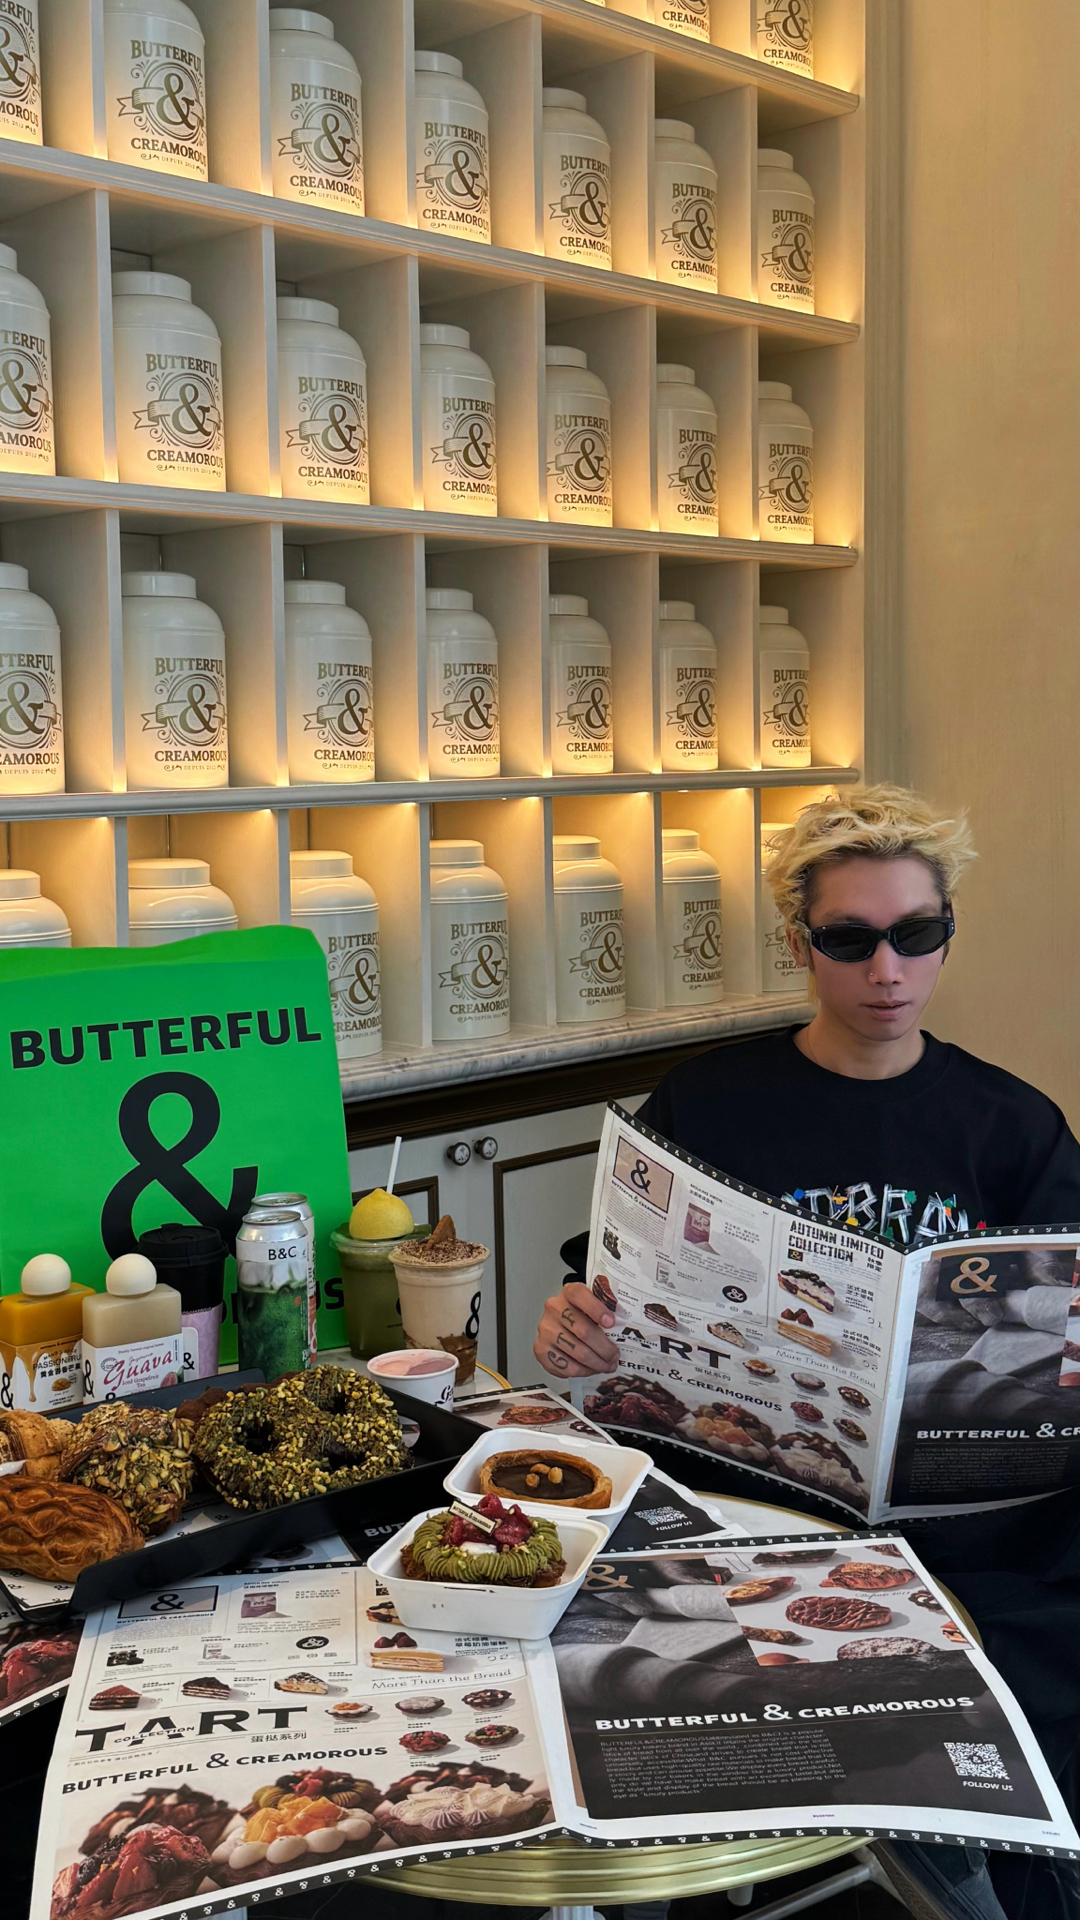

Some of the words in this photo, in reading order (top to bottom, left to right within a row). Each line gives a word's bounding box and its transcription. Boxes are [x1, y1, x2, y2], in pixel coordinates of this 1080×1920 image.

[782, 0, 808, 42] &
[131, 40, 203, 76] BUTTERFUL
[156, 72, 195, 130] &
[291, 83, 359, 118] BUTTERFUL
[314, 113, 351, 167] &
[445, 150, 480, 200] &
[579, 181, 607, 228] &
[690, 207, 714, 252] &
[788, 232, 812, 274] &
[146, 354, 219, 382] BUTTERFUL
[0, 359, 38, 418] &
[298, 376, 365, 403] BUTTERFUL
[172, 383, 212, 436] &
[321, 404, 357, 454] &
[147, 449, 224, 468] CREAMOROUS
[463, 422, 491, 469] &
[574, 438, 604, 482] &
[695, 452, 716, 494] &
[786, 464, 809, 504] &
[155, 657, 224, 677] BUTTERFUL
[0, 681, 44, 735] &
[179, 683, 217, 734] &
[338, 688, 368, 736] &
[464, 685, 493, 730] &
[585, 687, 610, 729] &
[693, 688, 716, 728] &
[789, 689, 809, 727] &
[155, 750, 227, 762] CREAMOROUS
[598, 931, 622, 973] &
[700, 920, 721, 959] &
[350, 958, 377, 1004] &
[472, 944, 502, 988] &
[10, 1007, 321, 1069] BUTTERFUL
[101, 1071, 258, 1263] &
[630, 1159, 651, 1195] &
[268, 1246, 297, 1260] B&C
[788, 1235, 853, 1262] COLLECTION
[790, 1220, 836, 1245] AUTUMN
[840, 1235, 884, 1260] LIMITED
[950, 1256, 997, 1294] &
[84, 1359, 95, 1398] &
[104, 1351, 172, 1391] Guava
[776, 1350, 802, 1362] More
[805, 1357, 829, 1369] Than
[832, 1364, 847, 1375] the
[850, 1371, 876, 1388] Bread
[1, 1372, 14, 1410] &
[668, 1368, 683, 1381] &
[687, 1378, 783, 1412] CREAMOROUS
[916, 1430, 1030, 1440] BUTTERFUL
[1036, 1423, 1055, 1438] &
[656, 1523, 681, 1531] FOLLOW
[580, 1565, 634, 1591] &
[150, 1594, 185, 1611] &
[411, 1678, 445, 1686] Than
[474, 1669, 511, 1680] Bread
[75, 1706, 308, 1753] TART
[595, 1713, 757, 1730] BUTTERFUL
[763, 1704, 792, 1720] &
[798, 1697, 974, 1719] CREAMOROUS
[114, 1726, 195, 1744] COLLECTION
[62, 1763, 199, 1795] BUTTERFUL
[206, 1753, 229, 1768] &
[236, 1746, 388, 1765] CREAMOROUS
[963, 1780, 999, 1789] FOLLOW
[1002, 1783, 1014, 1791] US
